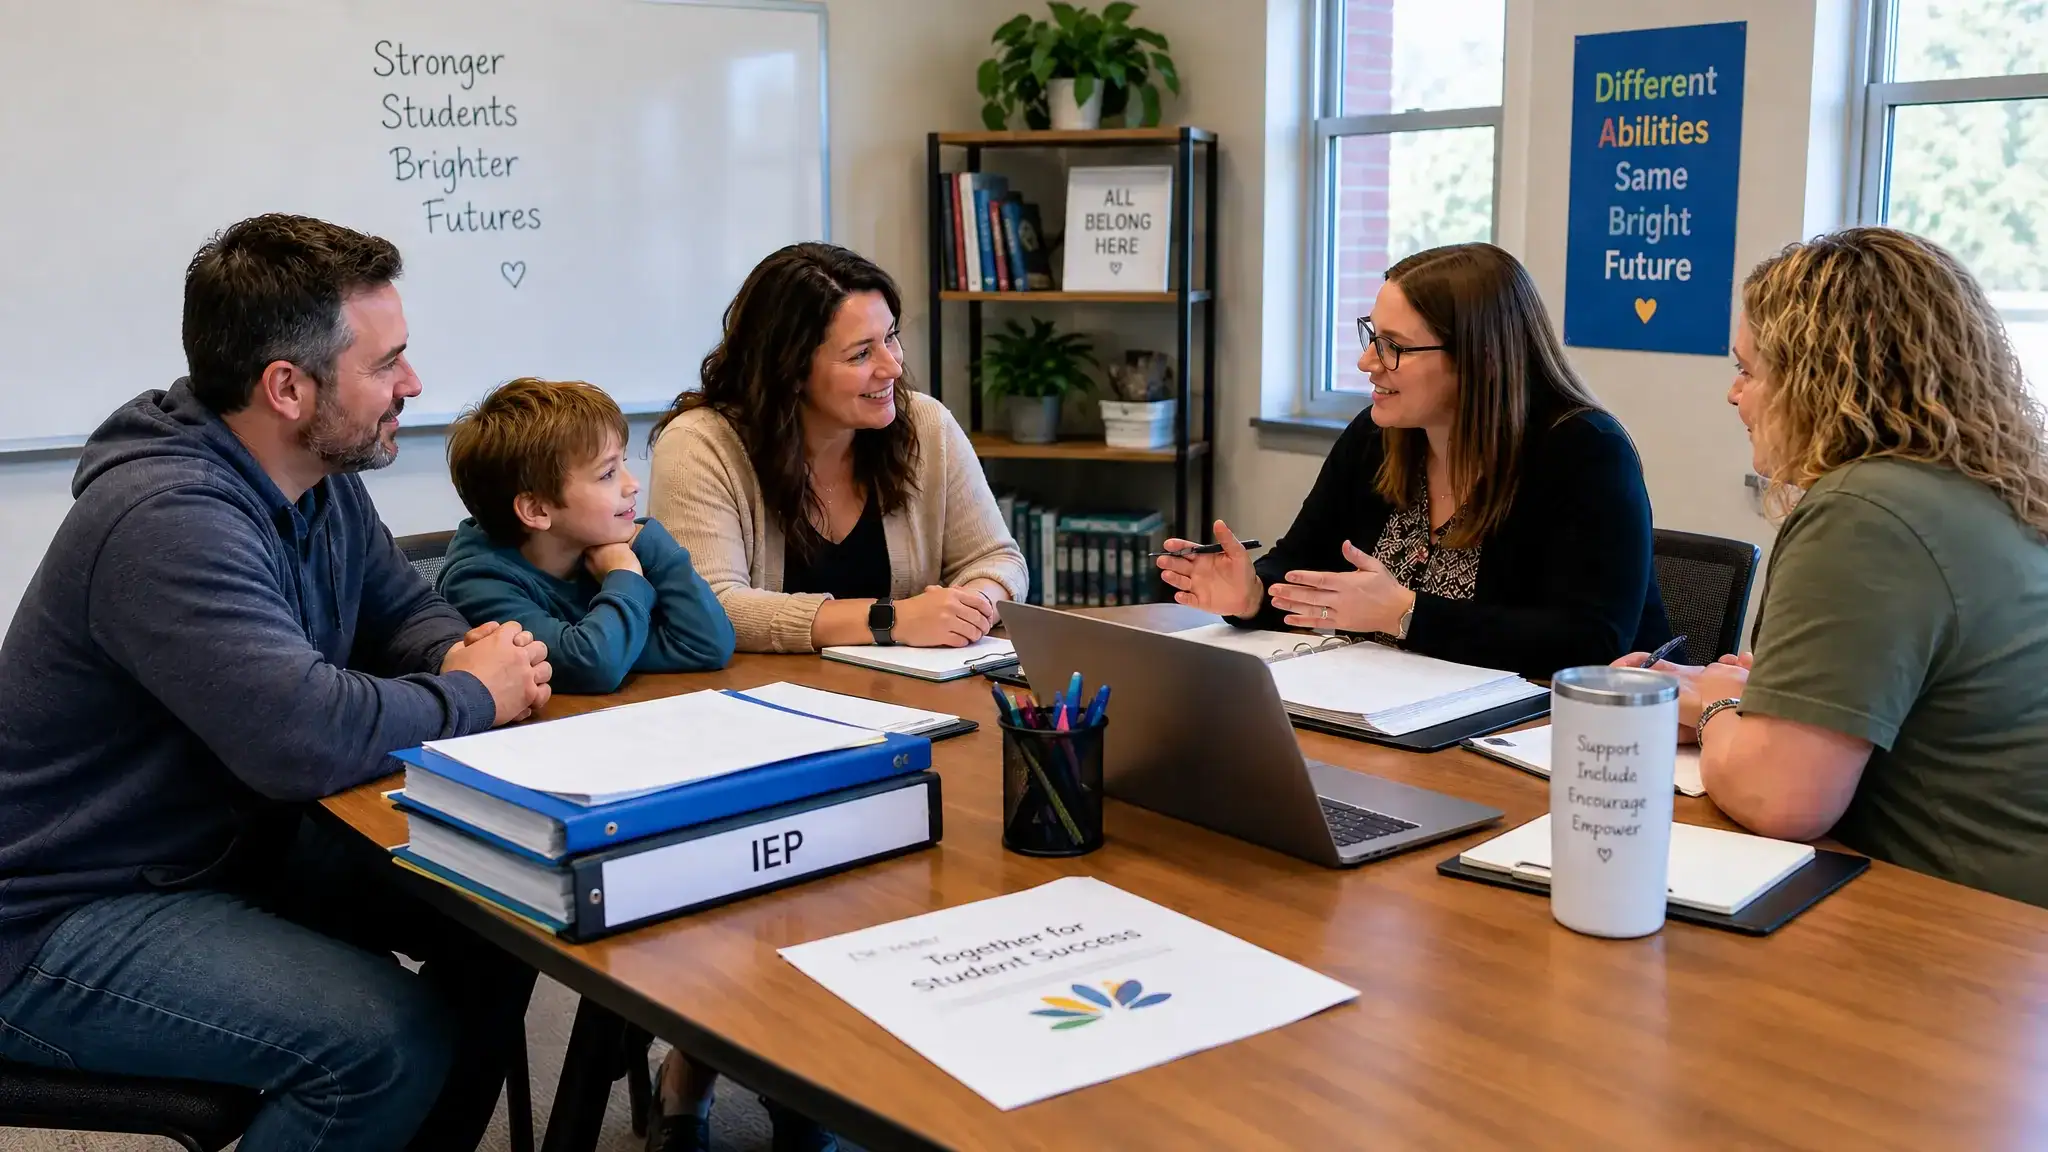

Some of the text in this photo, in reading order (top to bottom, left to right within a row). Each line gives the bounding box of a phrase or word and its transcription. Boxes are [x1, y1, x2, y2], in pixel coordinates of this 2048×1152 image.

[373, 40, 504, 90] Stronger
[1595, 66, 1718, 103] Different
[382, 93, 517, 129] Students
[1598, 114, 1709, 148] Abilities
[389, 144, 519, 194] Brighter
[1614, 161, 1688, 191] Same
[1103, 189, 1135, 207] ALL
[422, 198, 541, 233] Futures
[1085, 213, 1151, 231] BELONG
[1608, 204, 1692, 244] Bright
[1095, 237, 1139, 255] HERE
[1604, 249, 1692, 281] Future
[1577, 734, 1639, 761] Support
[1577, 762, 1637, 783] Include
[1568, 787, 1646, 817] Encourage
[1572, 814, 1641, 840] Empower
[751, 829, 804, 873] IEP
[911, 929, 1141, 992] Student Success
[922, 932, 1043, 967] Together
[1046, 921, 1084, 938] for
